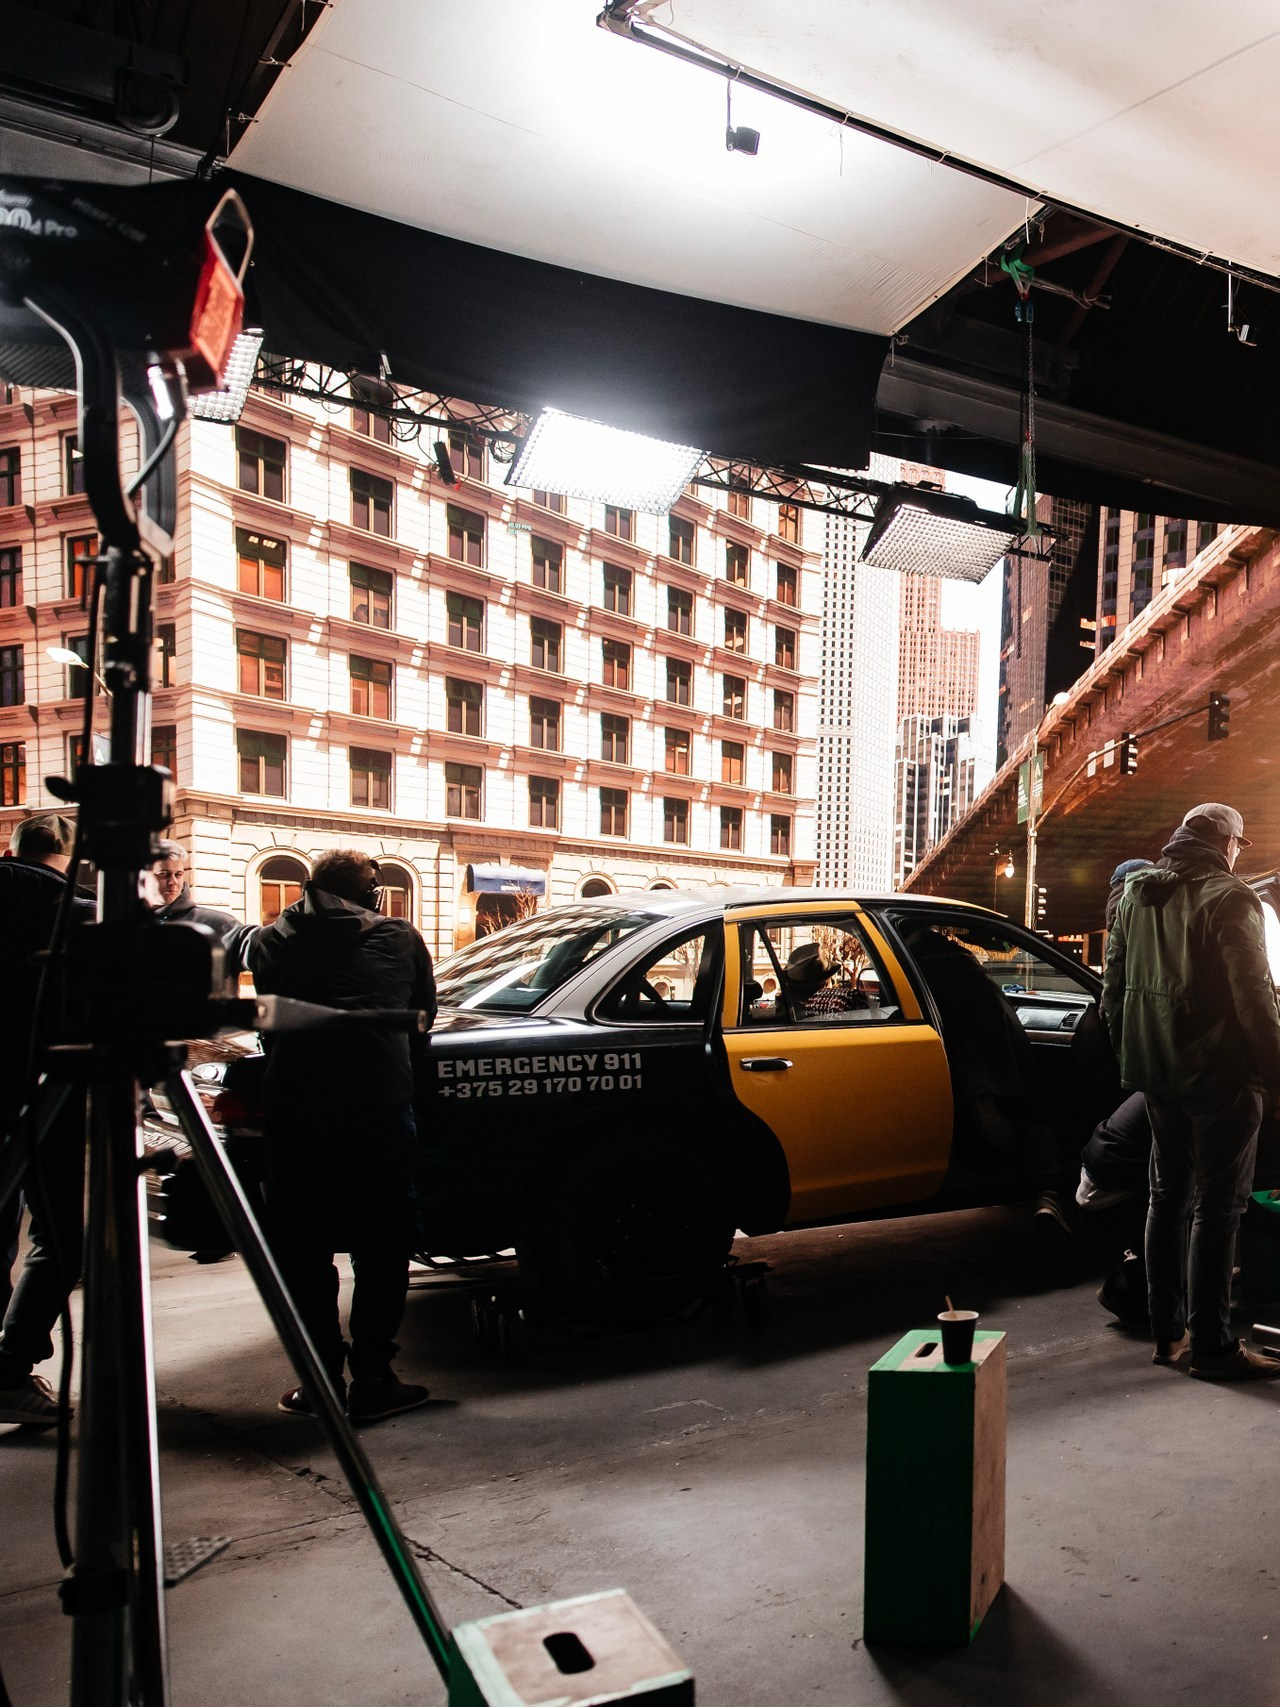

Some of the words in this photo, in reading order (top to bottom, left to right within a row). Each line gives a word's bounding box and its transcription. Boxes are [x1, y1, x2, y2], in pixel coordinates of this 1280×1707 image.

[437, 1053, 598, 1079] EMERGENCY
[603, 1052, 642, 1070] 911
[438, 1081, 503, 1099] +375
[508, 1079, 538, 1096] 29
[542, 1076, 583, 1094] 170
[586, 1075, 614, 1091] 70
[619, 1074, 643, 1090] 01
